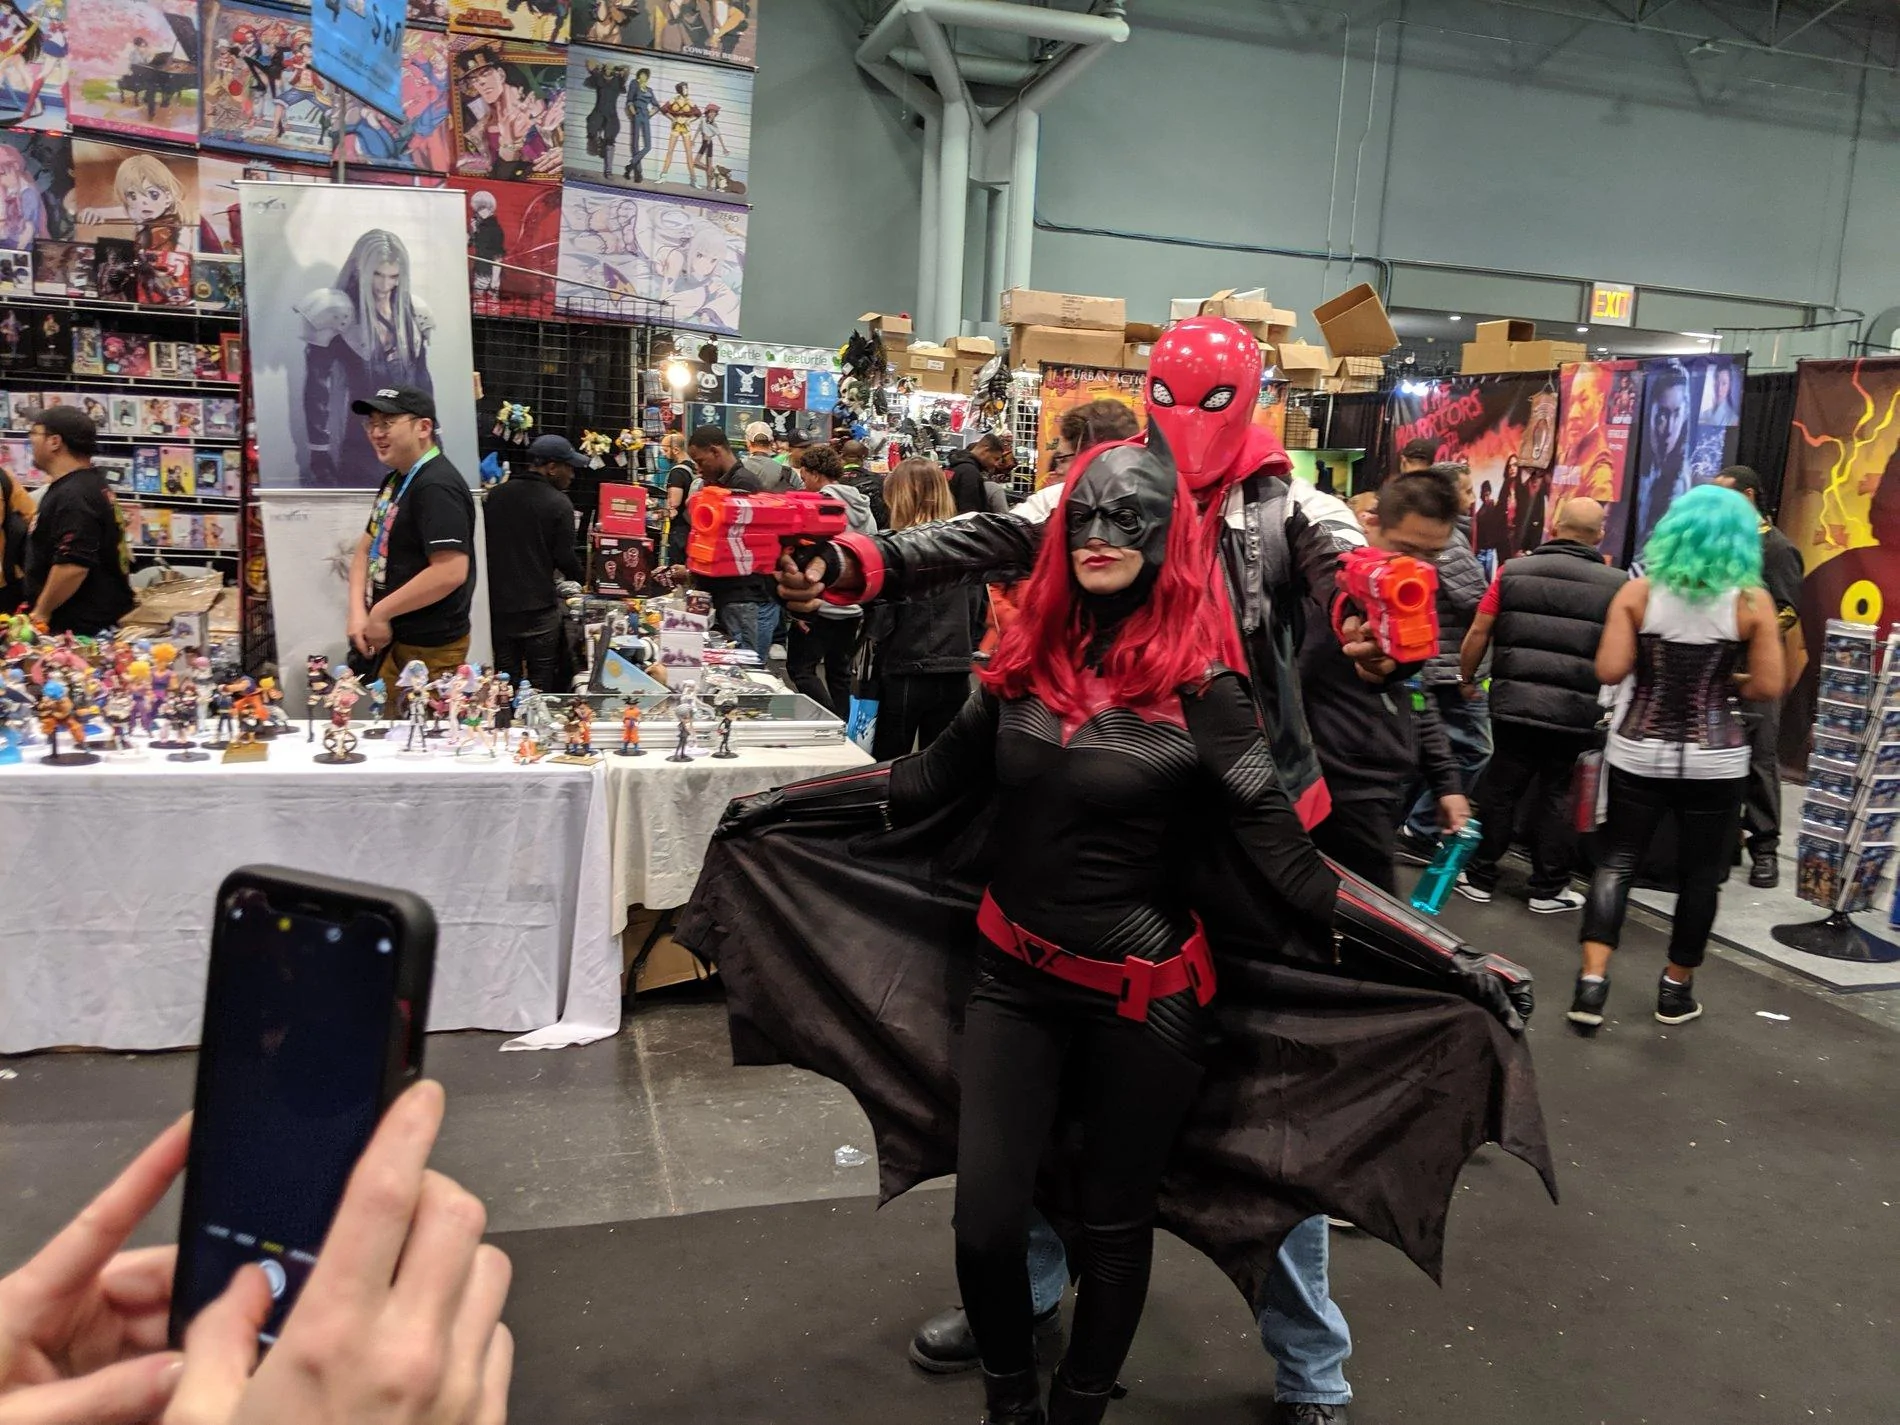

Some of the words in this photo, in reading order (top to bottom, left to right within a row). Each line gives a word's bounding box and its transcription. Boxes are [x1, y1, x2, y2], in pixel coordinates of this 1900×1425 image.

[682, 45, 720, 57] COWBOY
[722, 52, 751, 62] BEBOP
[1592, 289, 1633, 318] EXIT
[720, 348, 760, 360] eeturtle
[783, 353, 828, 366] teeturtle
[1072, 369, 1109, 382] URBAN
[1114, 374, 1148, 385] ACTIO
